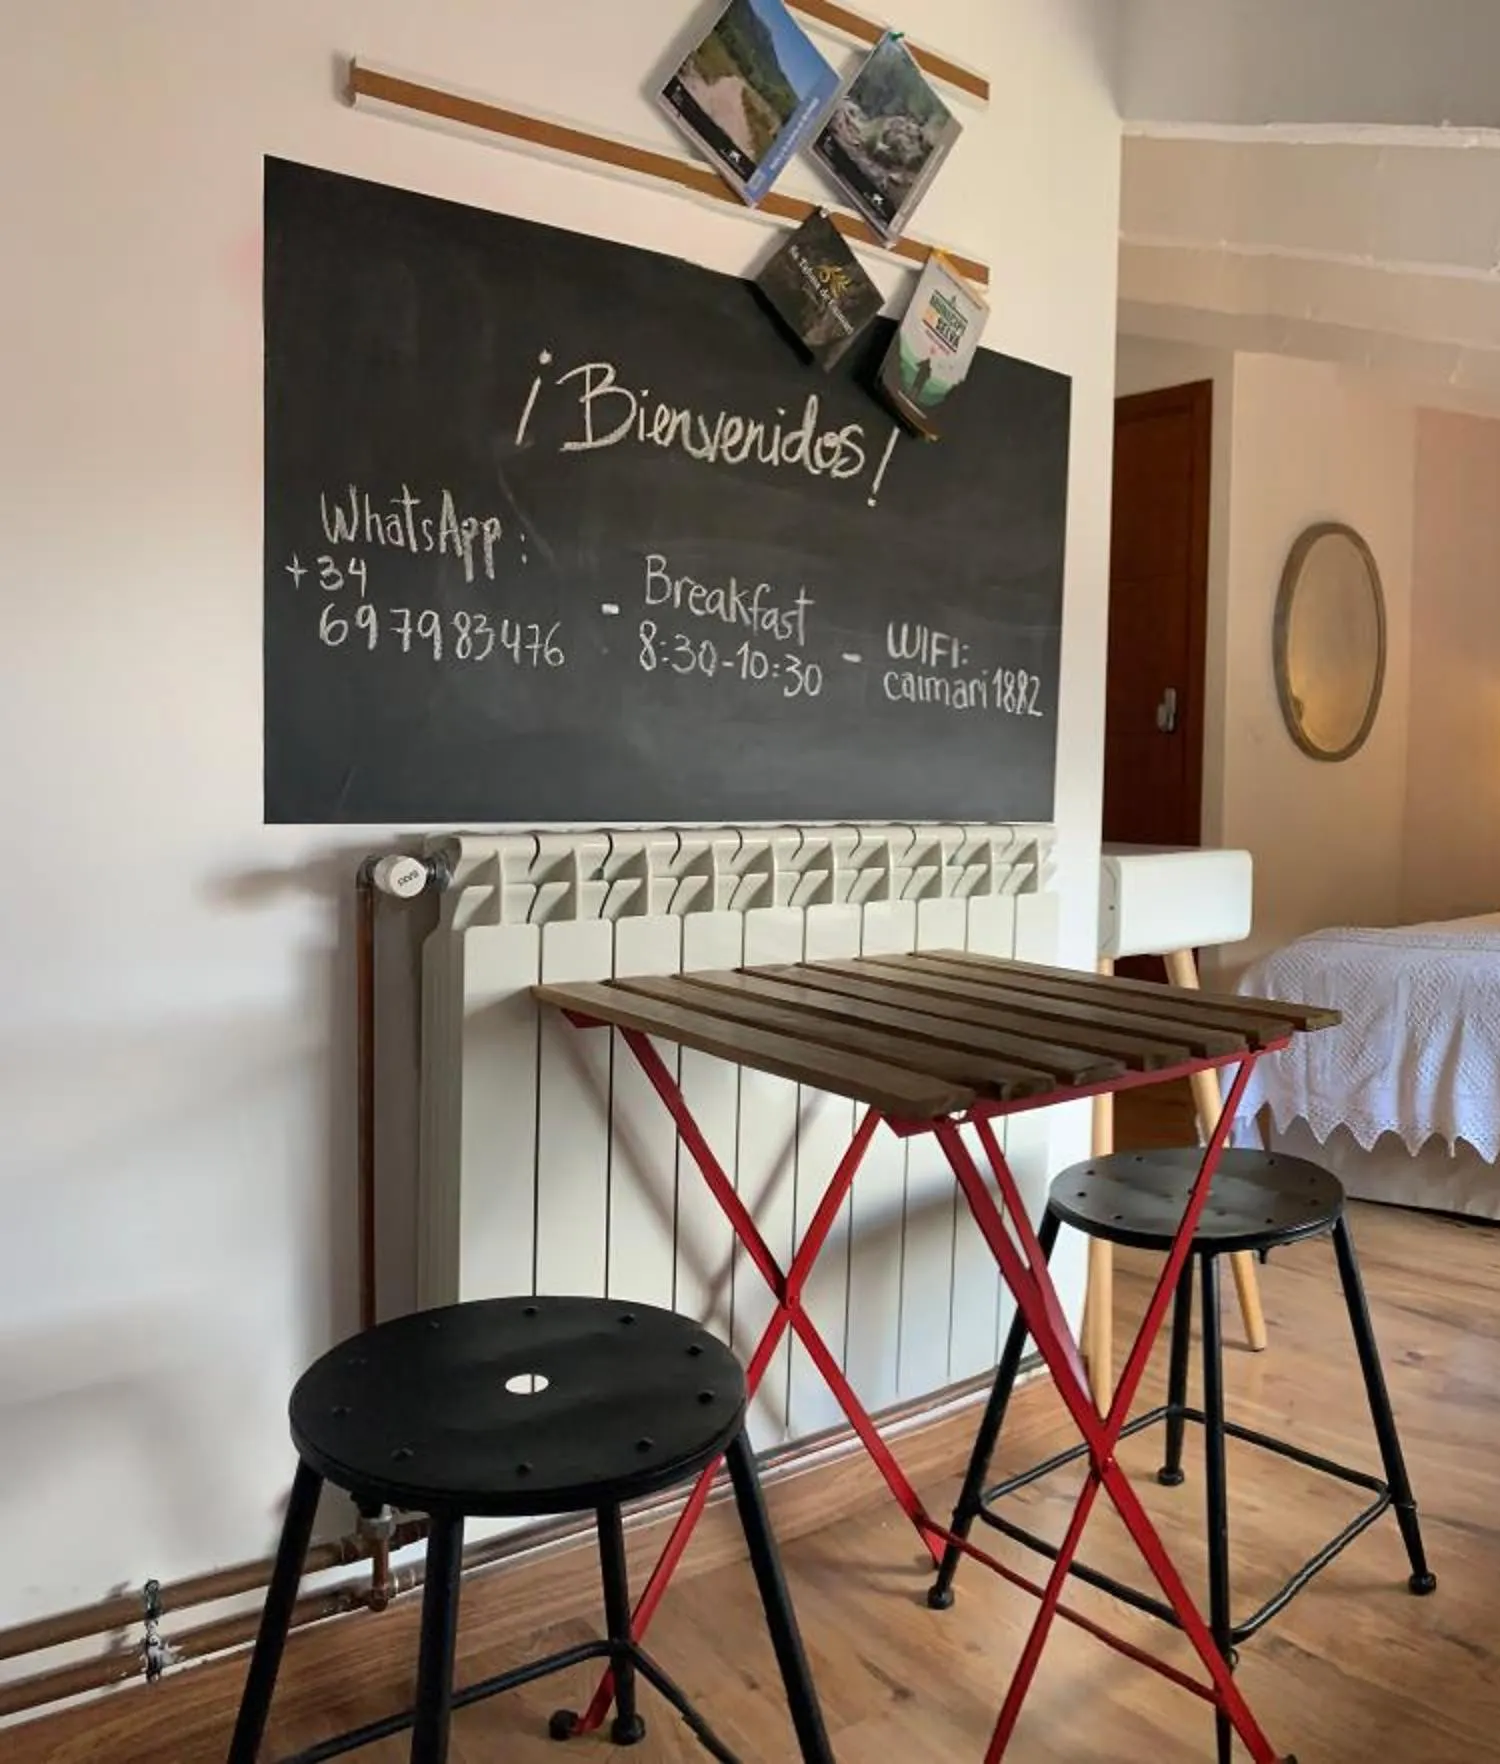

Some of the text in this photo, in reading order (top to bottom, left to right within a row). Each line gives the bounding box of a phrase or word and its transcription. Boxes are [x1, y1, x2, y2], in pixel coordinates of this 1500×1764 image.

[285, 552, 368, 598] +34
[644, 553, 816, 647] Breakfast
[639, 619, 824, 698] 8:30-10:30
[886, 620, 971, 669] WIFI:
